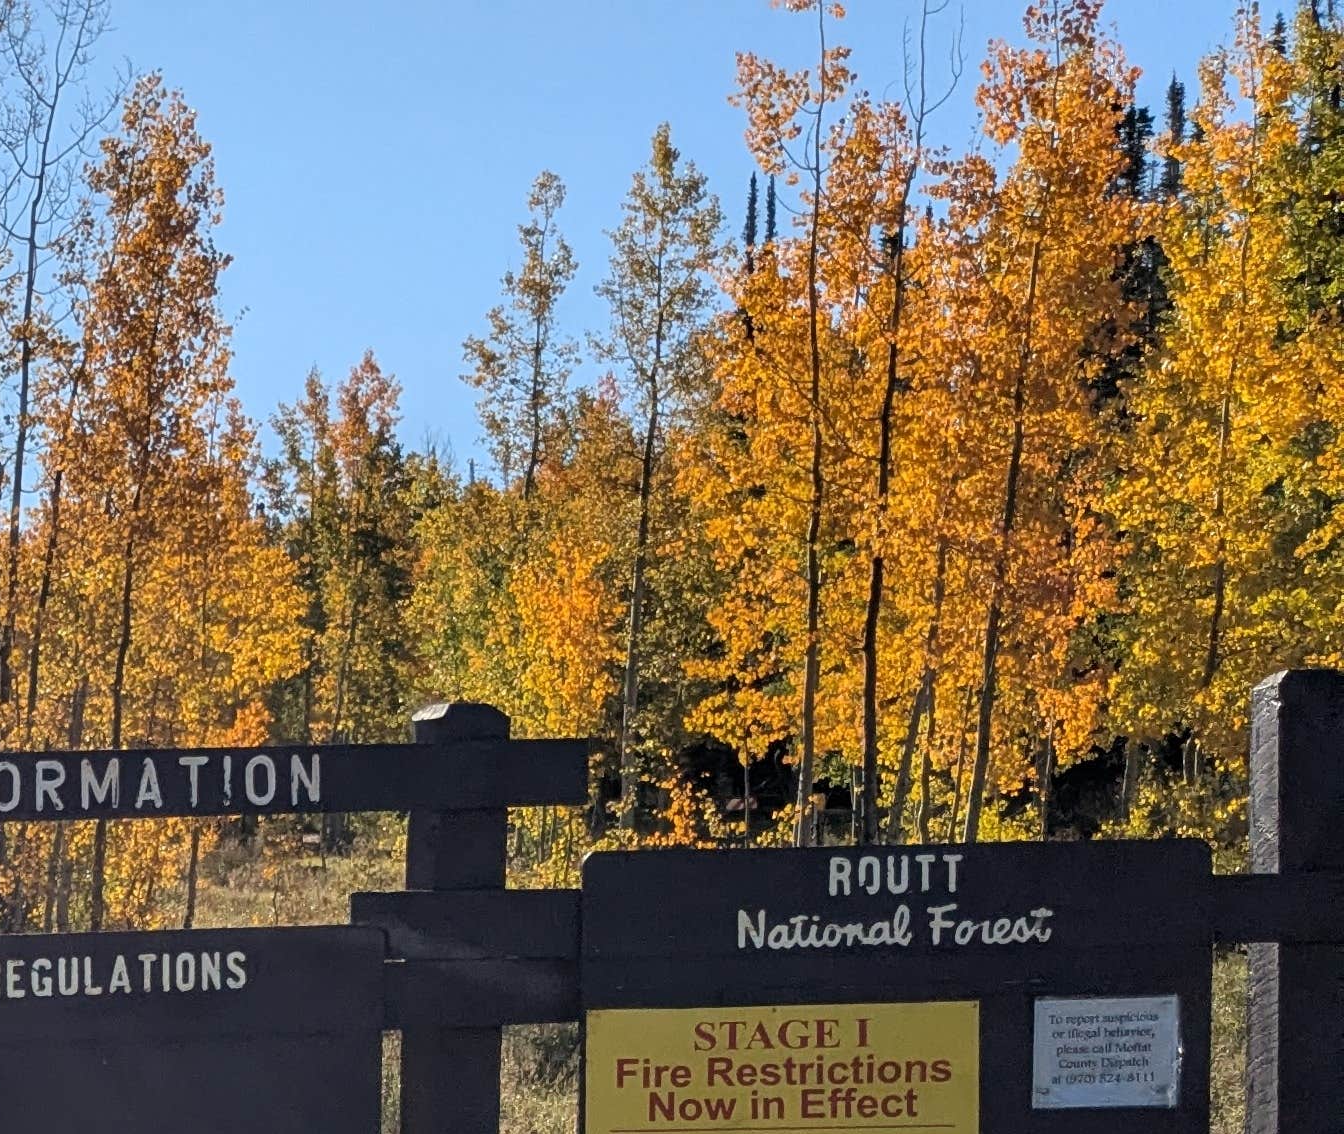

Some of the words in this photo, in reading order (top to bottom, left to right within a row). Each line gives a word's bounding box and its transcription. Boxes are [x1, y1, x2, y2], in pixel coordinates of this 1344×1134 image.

[829, 855, 962, 896] ROUTT
[737, 905, 912, 949] National
[927, 903, 1053, 946] Forest
[1048, 1015, 1062, 1024] To
[1066, 1014, 1100, 1026] report
[1103, 1013, 1159, 1024] suspicious
[694, 1019, 841, 1051] STAGE
[856, 1019, 871, 1047] I
[1052, 1031, 1065, 1039] or
[1068, 1028, 1100, 1040] illegal
[1057, 1044, 1088, 1056] please
[1093, 1044, 1110, 1054] call
[1115, 1043, 1152, 1052] Moffat
[616, 1058, 692, 1089] Fire
[707, 1055, 952, 1087] Restrictions
[1058, 1060, 1096, 1070] County
[1101, 1058, 1148, 1070] Dispatch
[1052, 1076, 1060, 1084] at
[648, 1091, 736, 1122] Now
[751, 1091, 784, 1119] in
[801, 1088, 918, 1119] Effect
